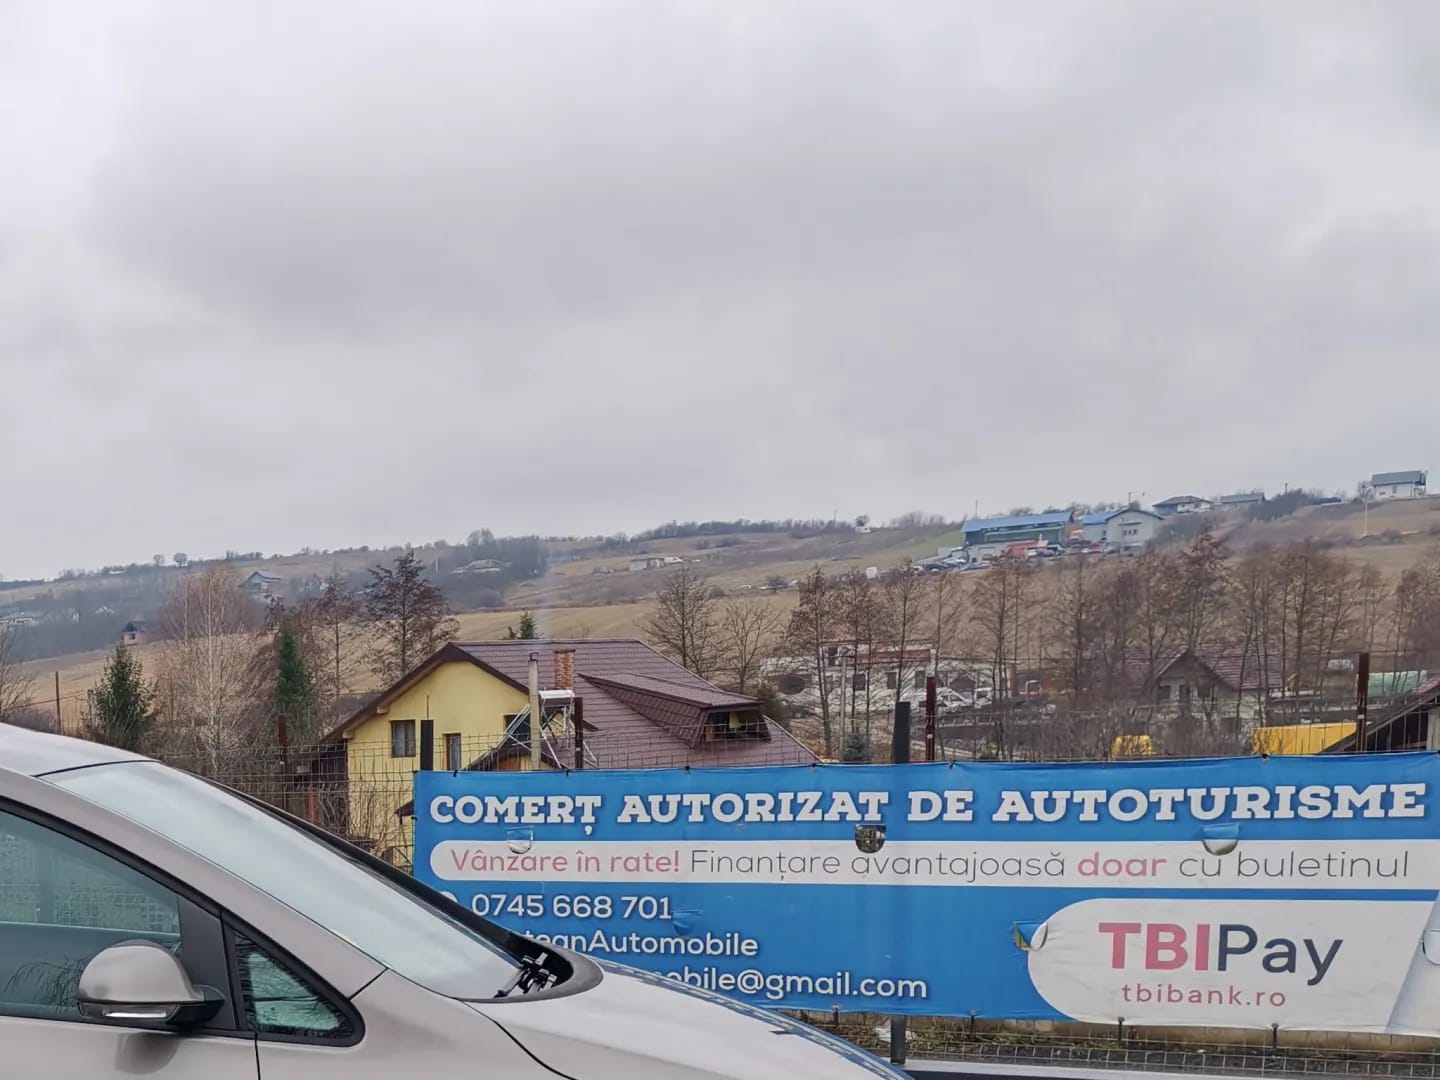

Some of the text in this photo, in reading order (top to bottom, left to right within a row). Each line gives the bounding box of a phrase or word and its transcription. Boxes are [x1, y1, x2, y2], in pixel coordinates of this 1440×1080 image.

[430, 783, 1427, 836] COMERȚ AUTORIZAT DE AUTOTURISME
[451, 848, 1408, 884] Vânzare în rate! Finanțare avantajoasă doar cu buletinul
[471, 894, 672, 919] 0745 668 701
[1098, 922, 1343, 986] TBIPay
[1122, 983, 1287, 1008] tbibank.ro
